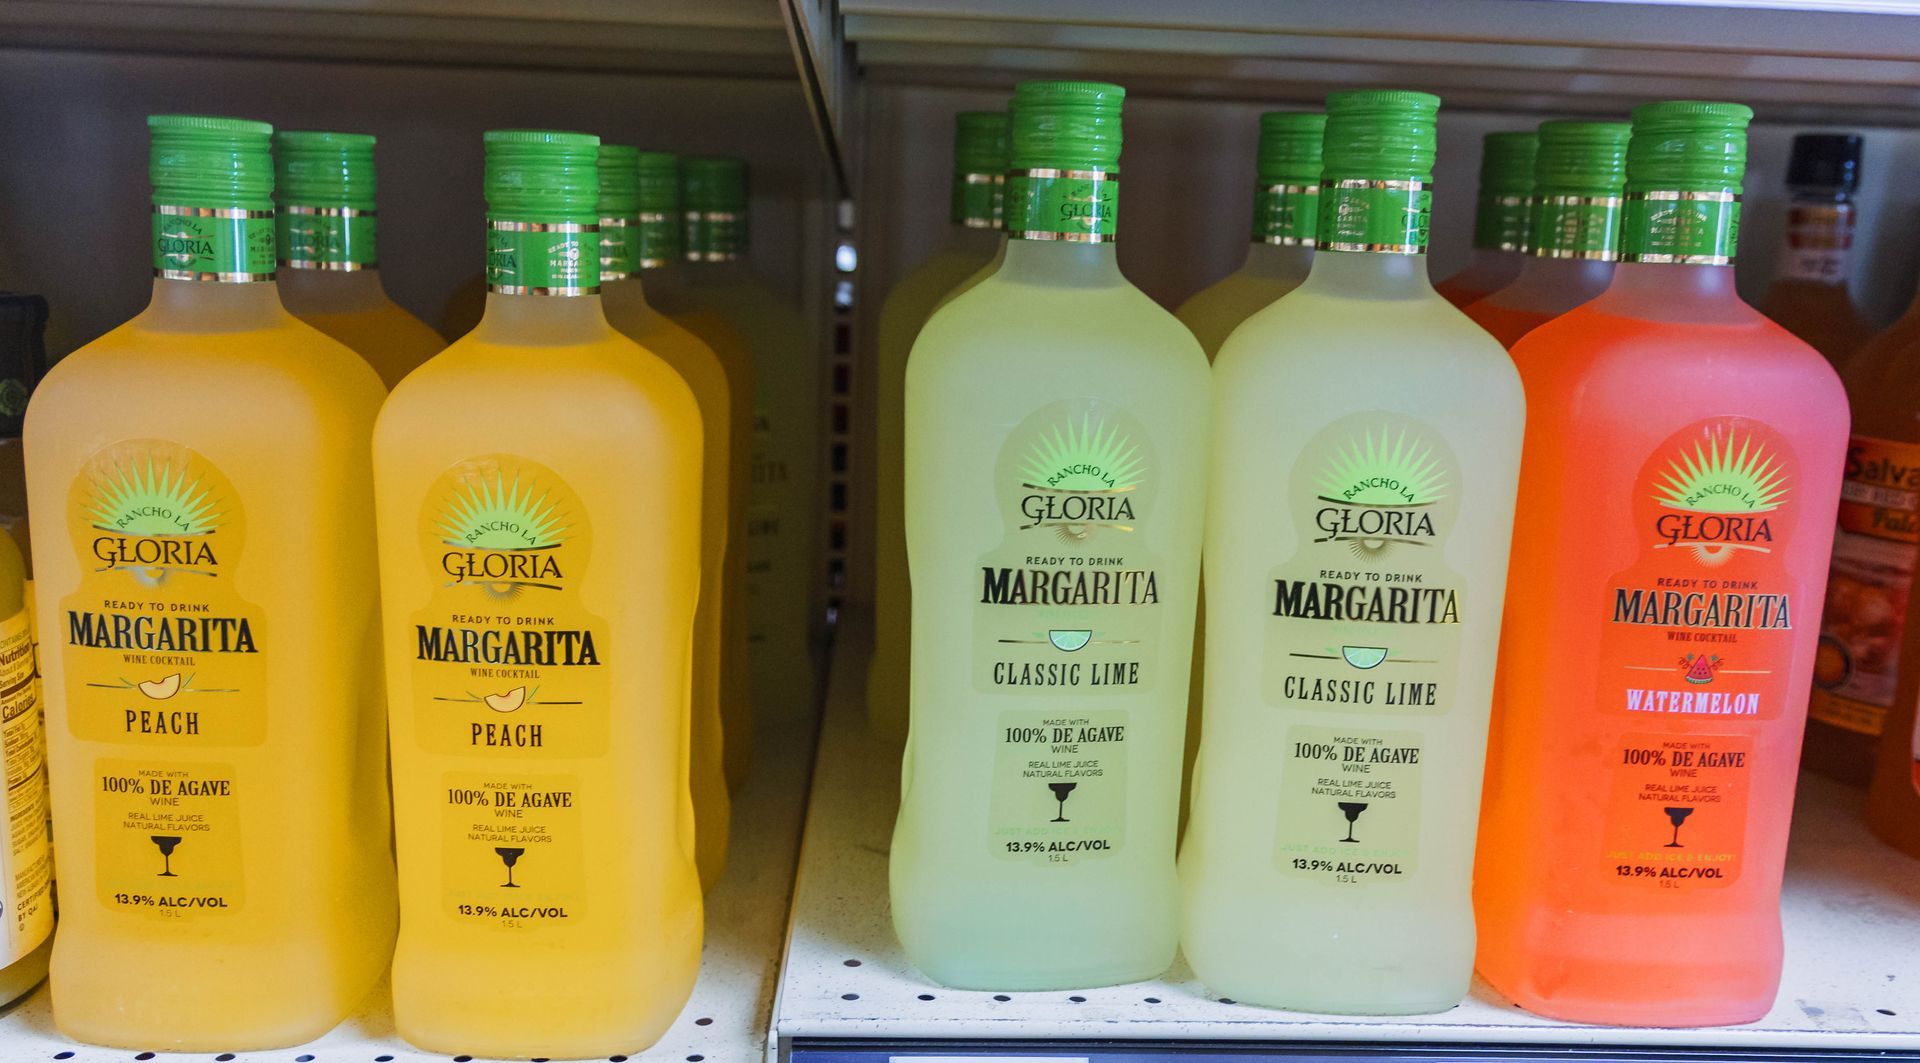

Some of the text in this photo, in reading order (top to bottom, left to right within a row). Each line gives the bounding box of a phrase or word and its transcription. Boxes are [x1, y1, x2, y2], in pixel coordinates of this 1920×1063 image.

[1047, 464, 1115, 488] RANCHO LA
[1344, 478, 1415, 502] RANCHO LA
[1686, 484, 1755, 508] RANCHO LA
[117, 506, 190, 532] RANCHO LA
[466, 521, 536, 545] RANCHO LA
[1026, 557, 1124, 566] READY TO DRINK
[1320, 570, 1422, 582] READY TO DRINK
[981, 567, 1158, 605] MARGARITA
[1658, 578, 1758, 589] READY TO DRINK
[104, 600, 210, 612] READY TO DRINK
[1273, 579, 1460, 624] MARGARITA
[1613, 588, 1792, 630] MARGARITA
[452, 615, 554, 625] READY TO DRINK
[68, 610, 258, 653] MARGARITA
[1667, 632, 1737, 643] WINE COCKTAIL
[416, 625, 600, 665] MARGARITA
[123, 653, 195, 666] WINE COCKTAIL
[470, 668, 539, 679] WINE COCKTAIL
[994, 662, 1139, 685] CLASSIC LIME
[1284, 676, 1437, 705] CLASSIC LIME
[1627, 689, 1760, 715] WATERMELON
[125, 709, 200, 735] PEACH
[471, 723, 542, 747] PEACH
[1006, 726, 1124, 743] 100% DE AGAVE
[1051, 745, 1078, 754] WINE
[1294, 742, 1419, 764] 100% DE AGAVE
[1028, 761, 1050, 769] REAL
[1073, 760, 1099, 768] JUICE
[1623, 749, 1745, 768] 100% DE AGAVE
[1023, 769, 1103, 778] NATURAL FLAVORS
[1342, 764, 1370, 773] WINE
[1670, 769, 1697, 778] WINE
[102, 776, 230, 796] 100% DE AGAVE
[1318, 779, 1391, 789] REAL LIME JUICE
[1645, 784, 1717, 794] REAL LIME JUICE
[448, 789, 572, 808] 100% DE AGAVE
[1312, 787, 1396, 798] NATURAL FLAVORS
[1639, 793, 1680, 801] NATURAL
[150, 797, 180, 806] WINE
[128, 813, 203, 822] REAL LIME JUICE
[495, 809, 523, 818] WINE
[123, 821, 210, 832] NATURAL FLAVORS
[473, 824, 546, 834] REAL LIME JUICE
[468, 833, 552, 843] NATURAL FLAVORS
[1006, 840, 1110, 852] 13.9% ALC/VOL
[1293, 859, 1402, 874] 13.9% ALC/VOL
[1616, 865, 1723, 878] 13.9% ALC/VOL
[114, 893, 228, 908] 13.9% ALC/VOL
[458, 905, 567, 918] 13.9% ALC/VOL
